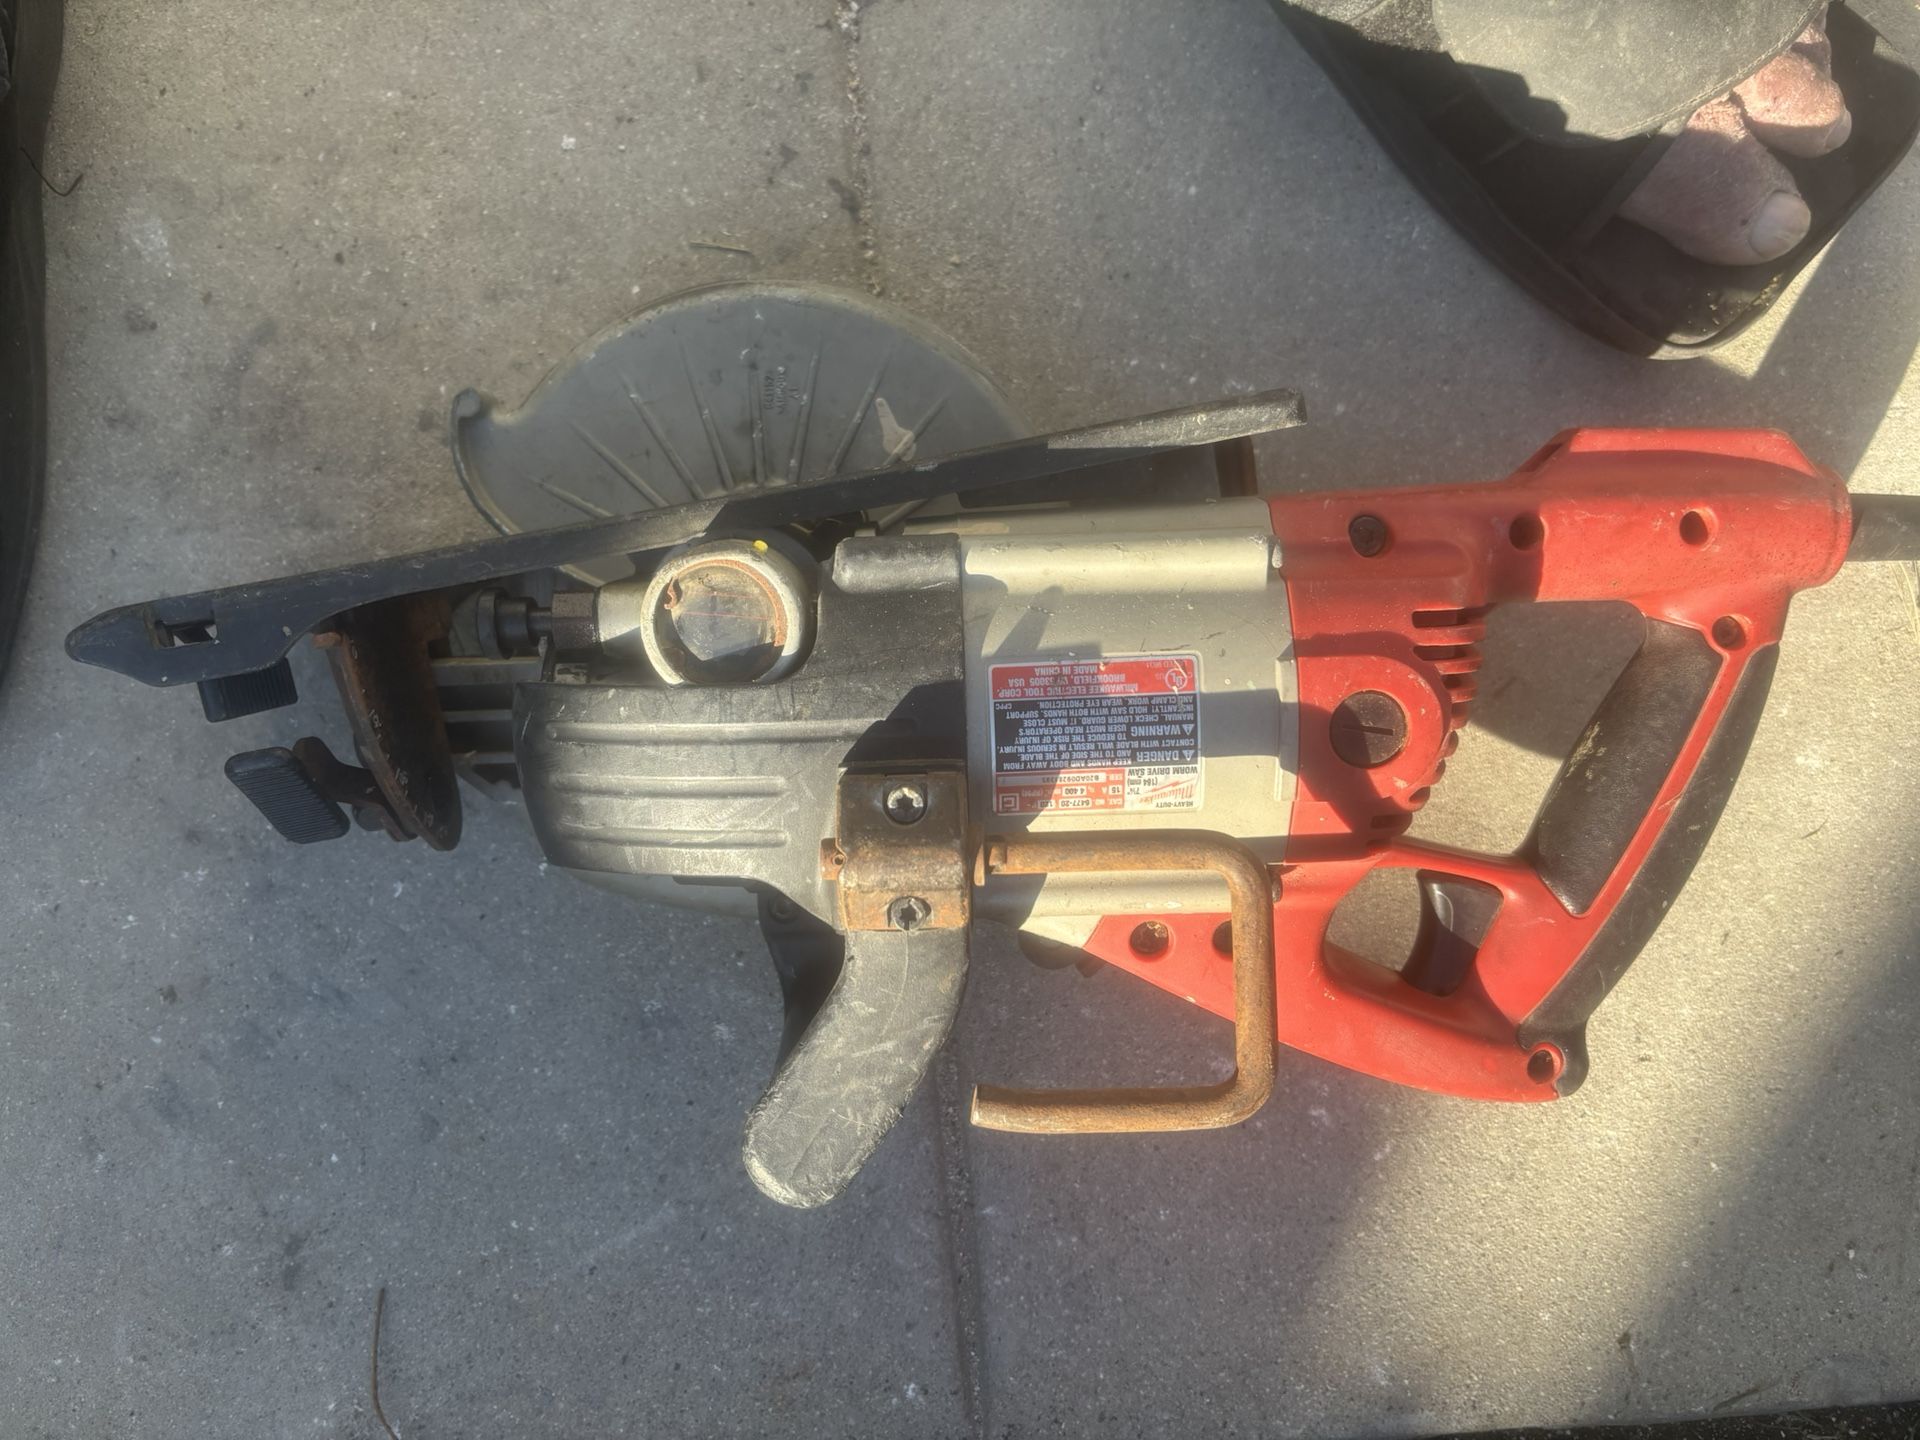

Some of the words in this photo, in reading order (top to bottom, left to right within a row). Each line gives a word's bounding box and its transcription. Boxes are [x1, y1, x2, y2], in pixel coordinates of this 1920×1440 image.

[1035, 667, 1060, 676] CHINA
[1062, 666, 1070, 675] IN
[1073, 665, 1097, 674] MADE
[1008, 678, 1024, 687] USA
[1070, 674, 1125, 685] BROOKFIELD,
[1024, 688, 1044, 697] TOOL
[1046, 686, 1086, 696] ELECTRIC
[1088, 683, 1138, 694] MILWAUKEE
[997, 689, 1021, 697] CORP.
[1087, 699, 1099, 707] EYE
[1102, 698, 1123, 706] WEAR
[1125, 697, 1149, 705] WORK.
[1177, 696, 1193, 704] AND
[1037, 700, 1084, 709] PROTECTION.
[1160, 713, 1193, 721] MANUAL.
[1023, 719, 1045, 727] CLOSE
[1048, 718, 1067, 726] MUST
[1019, 727, 1062, 735] OPERATOR'S
[1086, 725, 1105, 733] MUST
[1108, 724, 1126, 732] USER
[1131, 725, 1180, 736] WARNING
[1053, 735, 1069, 743] RISK
[1162, 739, 1194, 747] CONTACT
[1027, 744, 1057, 752] SERIOUS
[1017, 753, 1043, 761] BLADE.
[1136, 750, 1179, 762] DANGER
[1050, 760, 1068, 768] BODY
[1128, 768, 1145, 777] SAW
[1147, 767, 1170, 776] DRIVE
[1173, 766, 1198, 774] WORM
[1127, 779, 1141, 787] mm)
[1143, 777, 1158, 786] (184
[1139, 786, 1192, 804] Milwaukee
